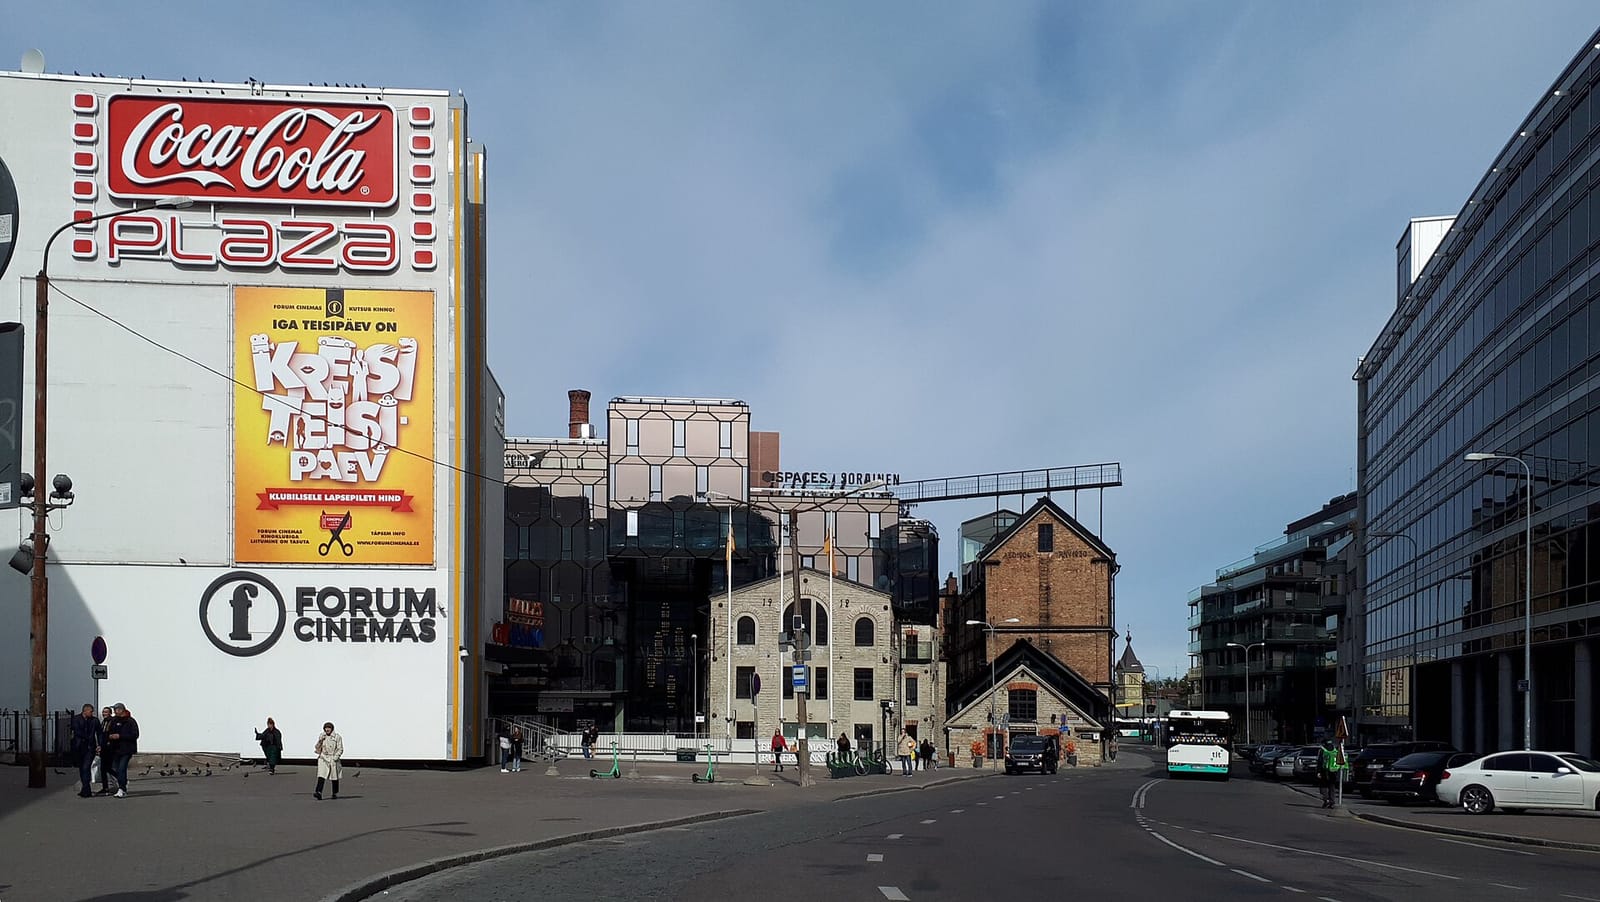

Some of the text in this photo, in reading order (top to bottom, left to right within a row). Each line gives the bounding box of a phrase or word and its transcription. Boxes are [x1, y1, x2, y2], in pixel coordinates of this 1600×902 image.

[121, 103, 381, 191] Coca-Cola
[272, 318, 397, 332] IGA TEISIPÄEV ON
[269, 493, 322, 501] KLUBILISELE
[324, 494, 376, 502] LAPSEPILETI
[295, 586, 437, 618] FORUM
[294, 617, 437, 643] CINEMAS
